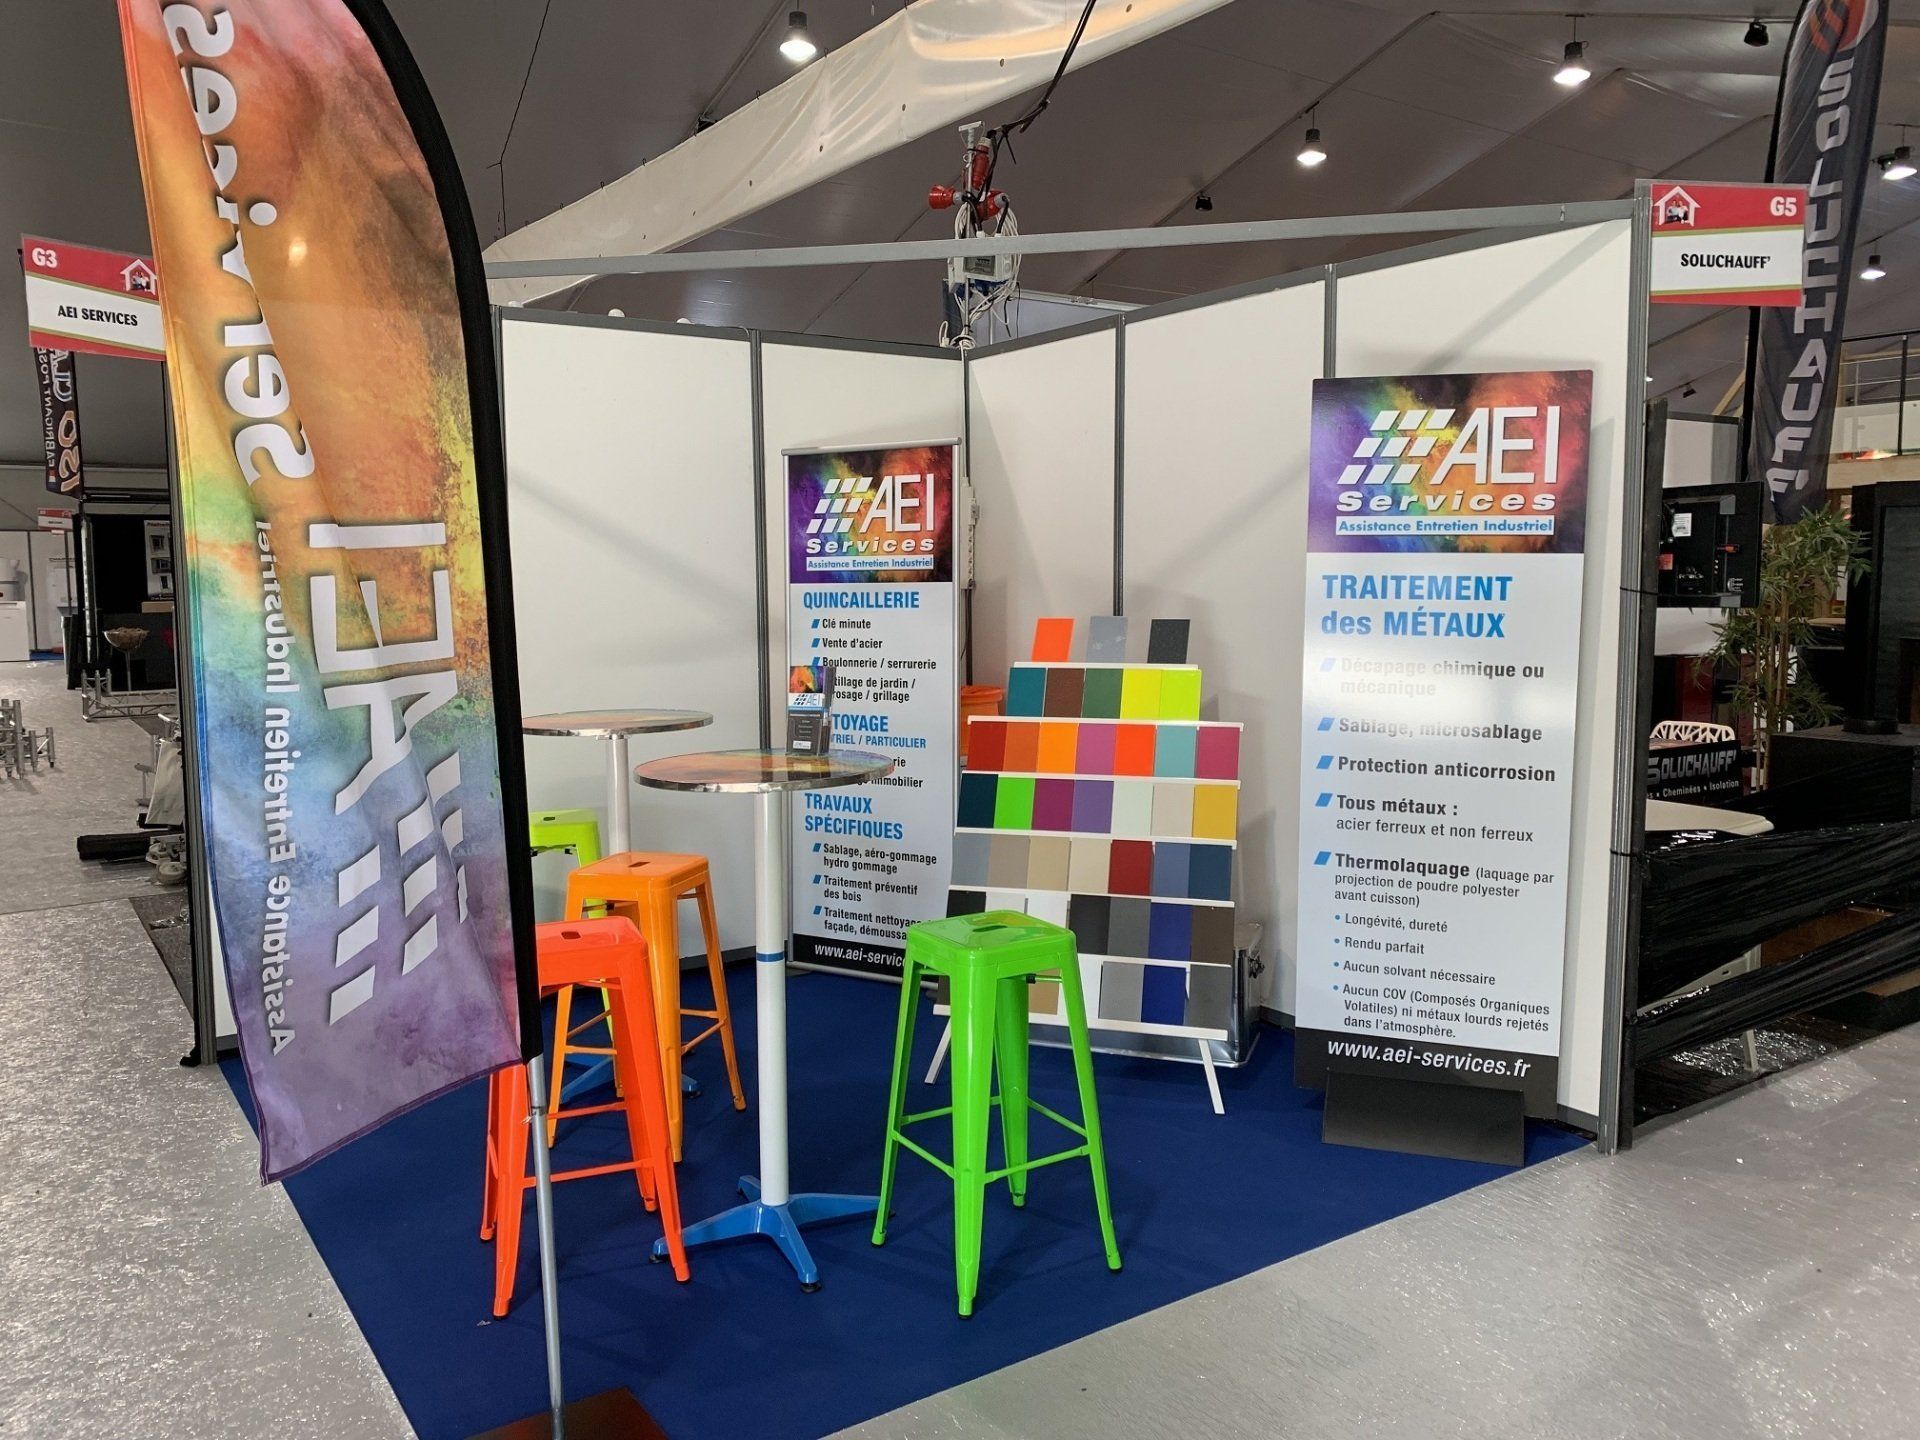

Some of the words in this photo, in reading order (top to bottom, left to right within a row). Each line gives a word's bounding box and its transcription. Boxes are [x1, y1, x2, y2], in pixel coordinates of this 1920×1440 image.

[1769, 197, 1797, 216] G5
[32, 248, 58, 268] G3
[58, 305, 78, 319] AEI
[82, 308, 138, 326] SERVICES
[1430, 405, 1560, 485] AEI
[860, 473, 934, 533] AEI
[1336, 490, 1556, 512] Services
[1338, 520, 1411, 532] Assistance
[1416, 520, 1478, 532] Entretien
[1484, 519, 1553, 532] Industriel
[806, 537, 934, 553] Services
[808, 559, 850, 569] Assistance
[852, 558, 889, 568] Entretien
[892, 557, 933, 568] Industriel
[1322, 574, 1513, 601] TRAITEMENT
[804, 591, 919, 609] QUINCAILLERIE
[822, 618, 836, 629] Clé
[839, 618, 871, 629] minute
[1321, 610, 1372, 635] des
[1383, 605, 1505, 638] MÉTAUX
[822, 637, 847, 648] Vente
[822, 656, 877, 668] Boulonnerie
[887, 659, 936, 670] serrurerie
[1341, 657, 1426, 677] Décapage
[1432, 660, 1516, 678] chimique
[1522, 665, 1545, 678] ou
[834, 677, 863, 689] tillage
[866, 677, 877, 688] de
[880, 677, 908, 690] jardin
[1340, 678, 1436, 697] mécanique
[872, 689, 910, 703] grillage
[832, 713, 888, 732] TOYAGE
[1339, 717, 1414, 738] Sablage,
[1420, 722, 1543, 743] microsablage
[866, 736, 926, 750] PARTICULIER
[1338, 755, 1428, 776] Protection
[1434, 762, 1556, 783] anticorrosion
[1662, 785, 1701, 798] Cheminées
[1709, 779, 1740, 792] Isolation
[805, 793, 872, 814] TRAVAUX
[1337, 794, 1376, 813] Tous
[1382, 796, 1447, 816] métaux
[805, 814, 903, 840] SPÉCIFIQUES
[1336, 817, 1372, 833] acier
[1375, 818, 1427, 836] ferreux
[1431, 823, 1445, 837] et
[1450, 826, 1476, 839] non
[1481, 825, 1534, 842] ferreux
[824, 843, 862, 858] Sablage,
[865, 847, 936, 865] aéro-gommage
[824, 856, 849, 869] hydro
[852, 861, 897, 874] gommage
[1335, 852, 1471, 879] Thermolaquage
[1476, 867, 1530, 884] (laquage
[1534, 872, 1555, 885] par
[824, 875, 872, 890] Traitement
[875, 881, 918, 896] préventif
[824, 888, 839, 900] des
[842, 890, 861, 902] bois
[1335, 873, 1395, 890] projection
[1398, 877, 1413, 890] de
[1416, 879, 1459, 895] poudre
[1463, 882, 1520, 898] polyester
[1335, 889, 1366, 903] avant
[1370, 891, 1421, 908] cuisson)
[824, 907, 873, 922] Traitement
[1345, 912, 1406, 931] Longévité,
[1409, 918, 1448, 933] dureté
[825, 920, 856, 935] façade,
[860, 924, 907, 940] démoussa
[1345, 937, 1381, 951] Rendu
[1385, 940, 1424, 956] parfait
[1343, 960, 1380, 975] Aucun
[1383, 963, 1427, 979] solvant
[1430, 968, 1496, 985] nécessaire
[1343, 984, 1380, 998] Aucun
[1383, 986, 1407, 1001] COV
[1410, 989, 1476, 1009] (Composés
[1480, 996, 1550, 1016] Organiques
[1344, 1000, 1398, 1017] Volatiles)
[1401, 1004, 1413, 1018] ni
[1416, 1006, 1461, 1023] métaux
[1464, 1011, 1503, 1027] lourds
[1506, 1014, 1550, 1032] rejetés
[1344, 1015, 1372, 1030] dans
[1327, 1039, 1532, 1080] www.aei-services.fr
